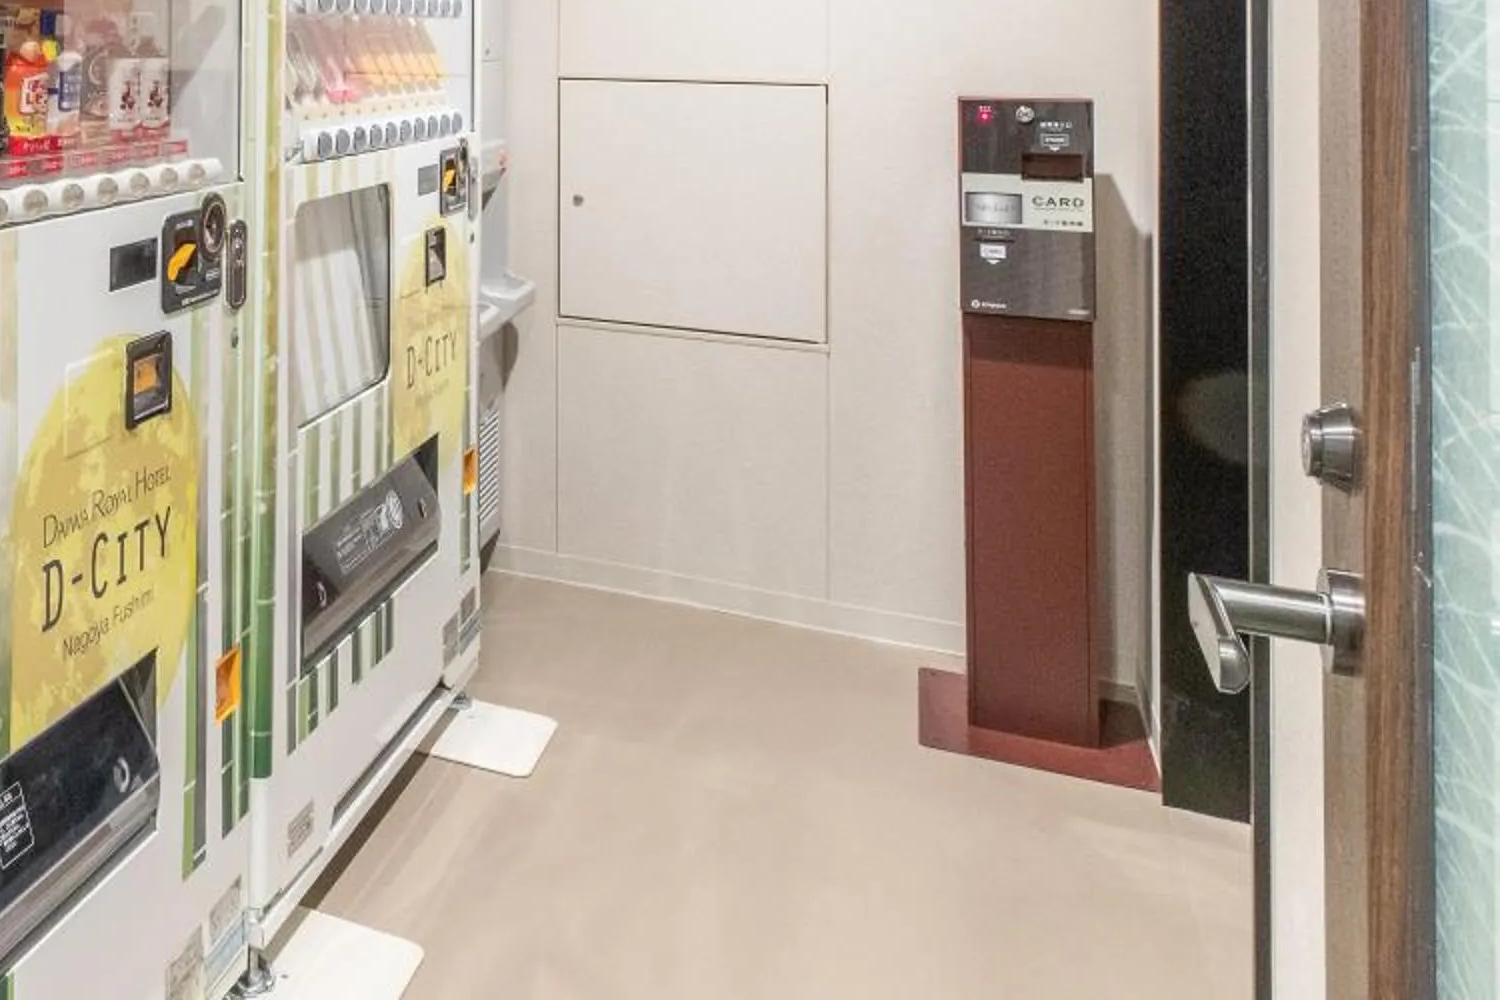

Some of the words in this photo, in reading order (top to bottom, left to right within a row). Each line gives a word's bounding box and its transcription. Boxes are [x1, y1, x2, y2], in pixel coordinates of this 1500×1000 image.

[1031, 195, 1085, 208] CARD
[406, 332, 456, 389] D-CITY
[135, 465, 172, 494] HOTEL
[41, 505, 171, 633] D-CITY
